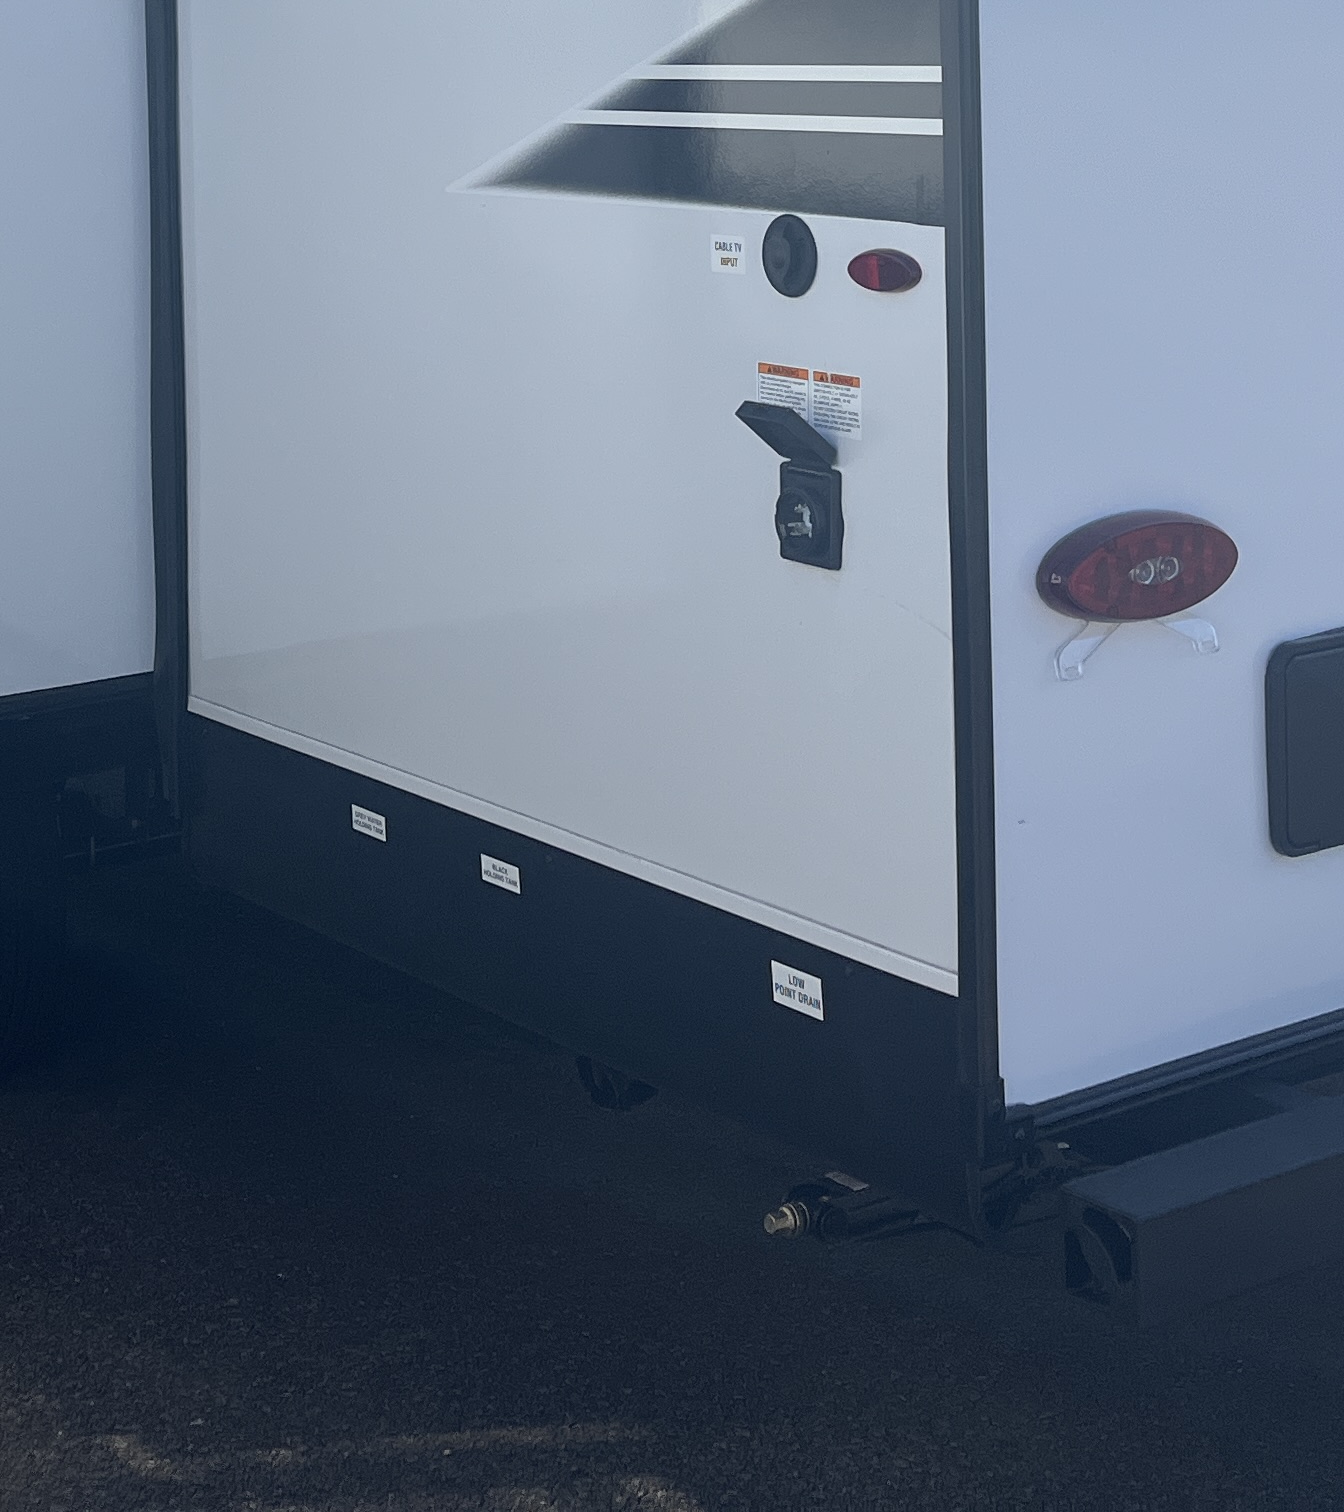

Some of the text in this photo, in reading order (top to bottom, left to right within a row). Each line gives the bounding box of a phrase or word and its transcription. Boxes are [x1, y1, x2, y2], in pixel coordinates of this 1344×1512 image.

[714, 241, 743, 253] CABLE TV
[788, 973, 805, 990] LOW
[774, 982, 821, 1011] POINT DRAIN
